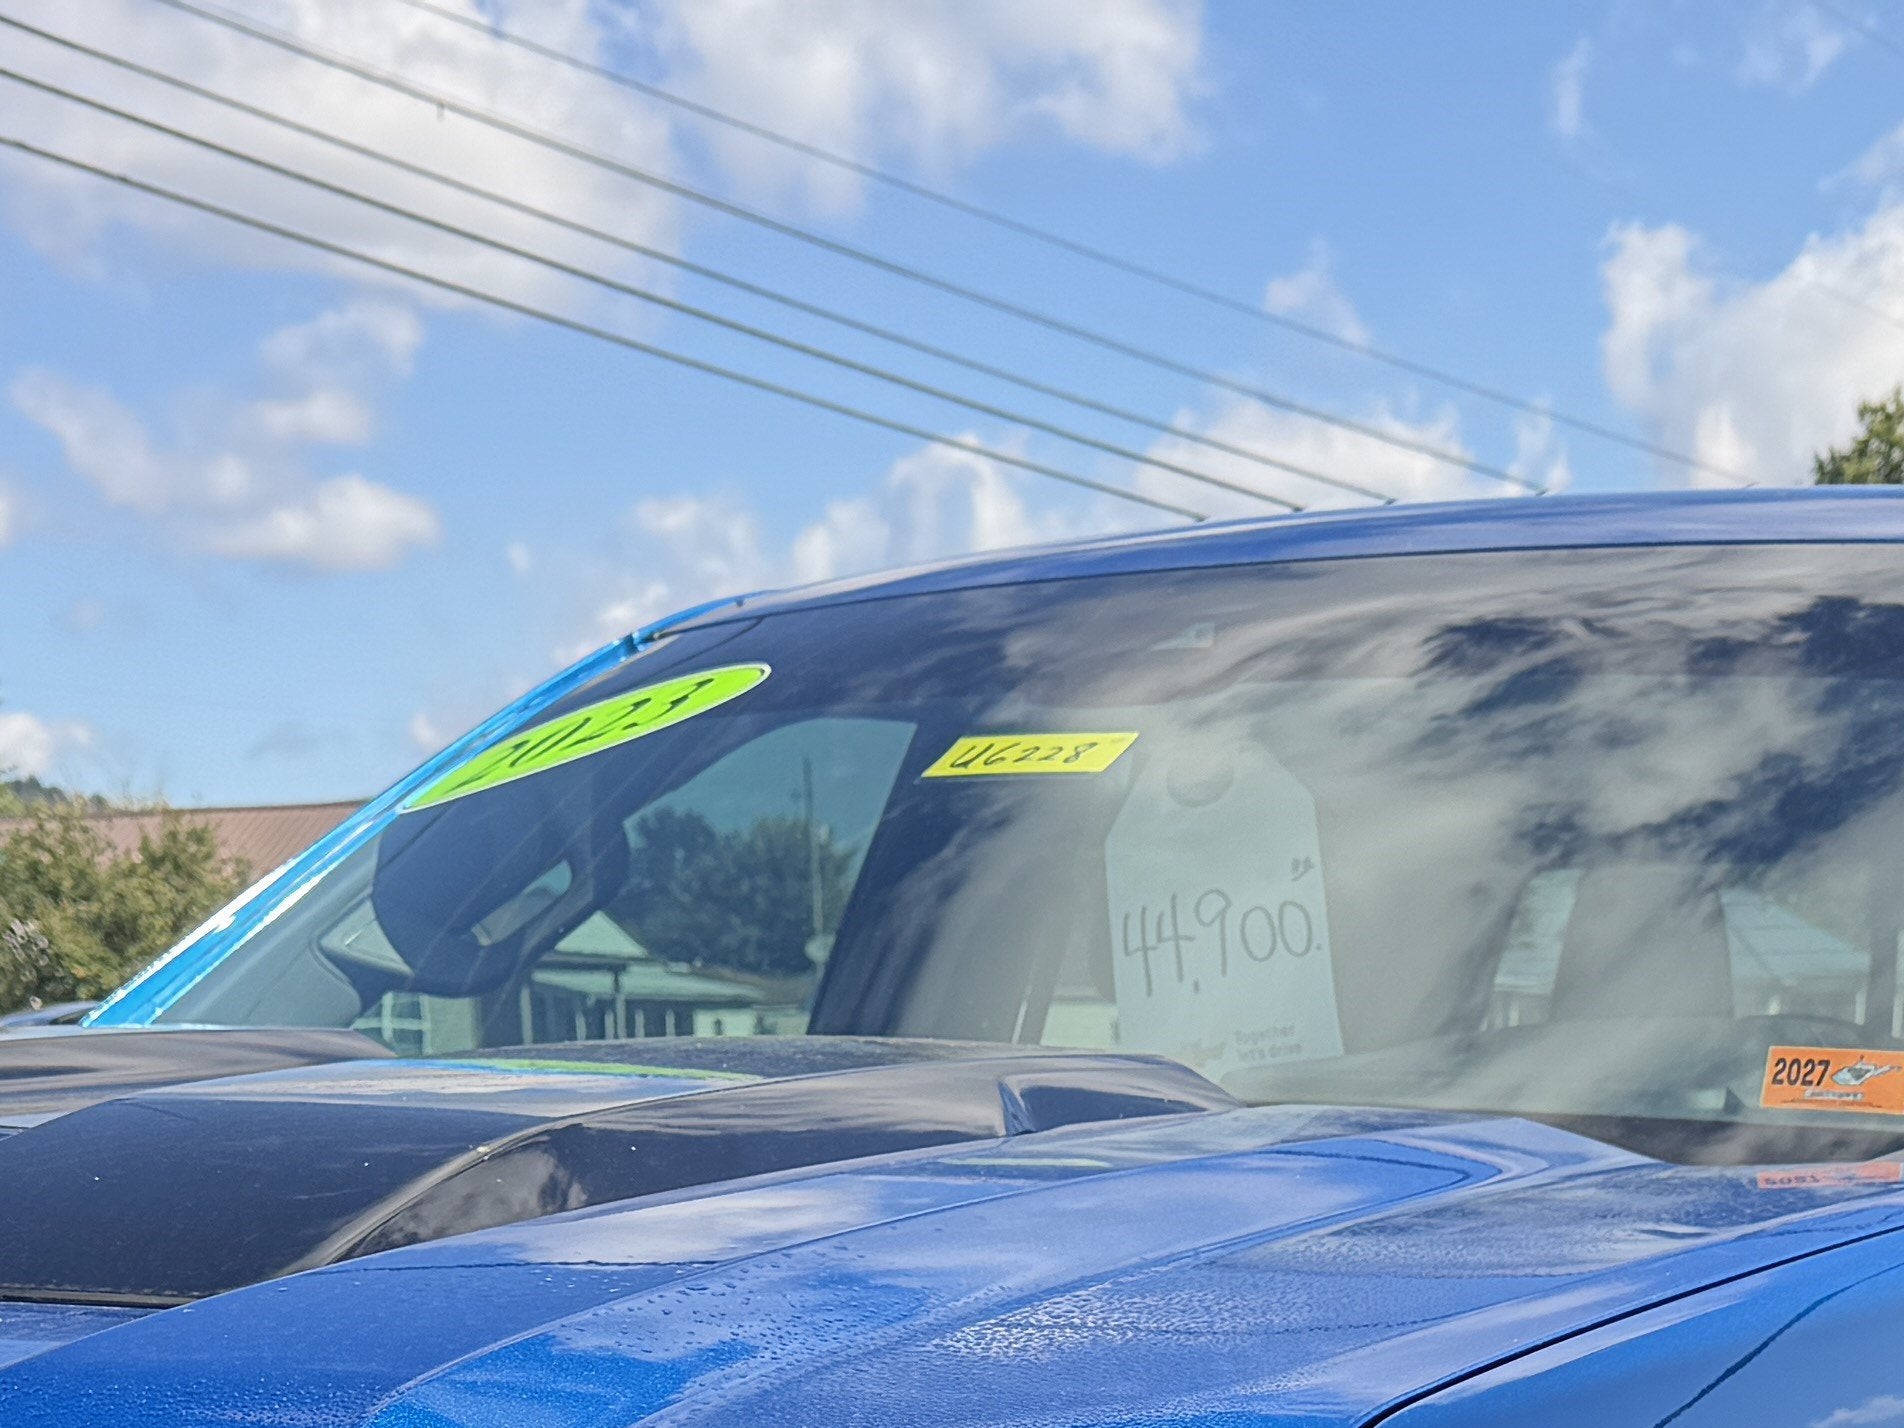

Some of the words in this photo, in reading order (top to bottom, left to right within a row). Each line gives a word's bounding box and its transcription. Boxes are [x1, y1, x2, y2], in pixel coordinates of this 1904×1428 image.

[422, 678, 715, 796] 2023
[949, 742, 1098, 769] U6228
[1771, 1057, 1831, 1087] 2027
